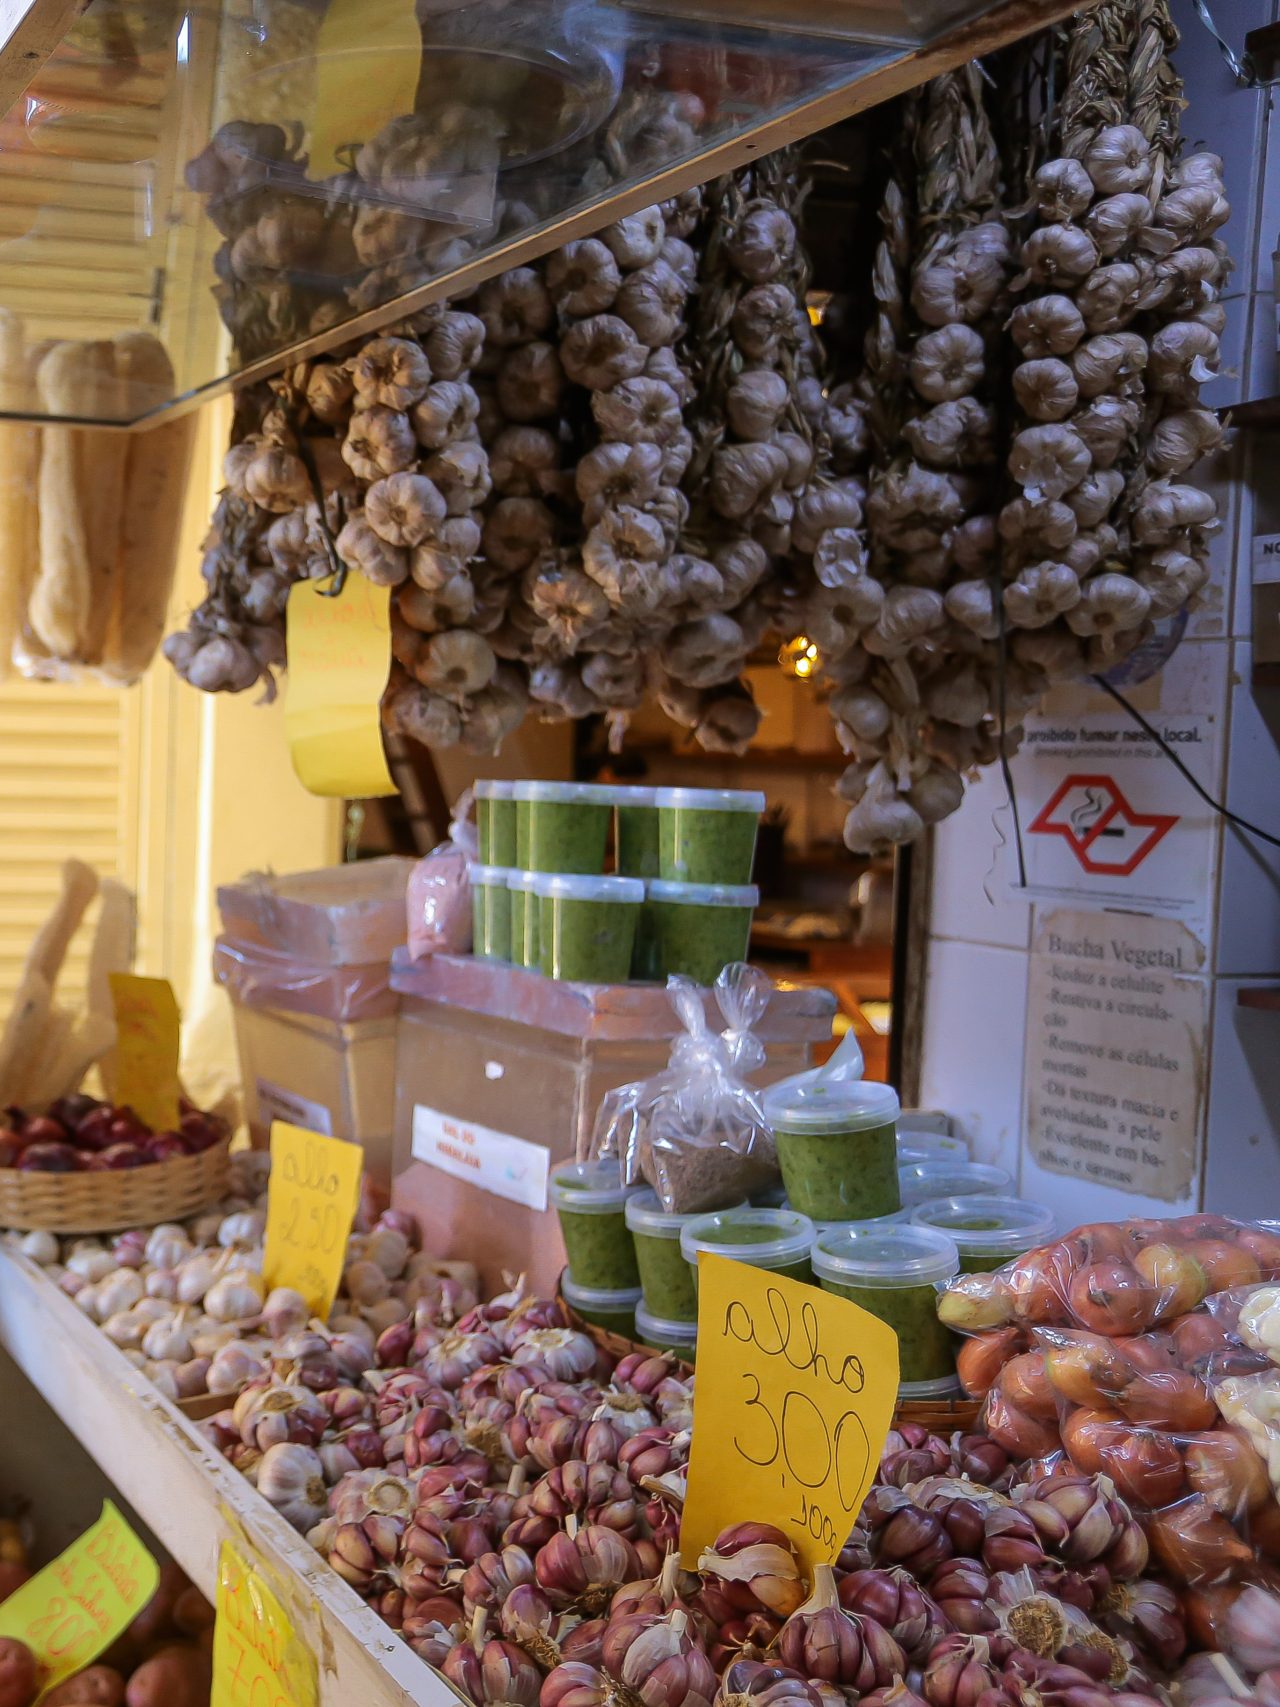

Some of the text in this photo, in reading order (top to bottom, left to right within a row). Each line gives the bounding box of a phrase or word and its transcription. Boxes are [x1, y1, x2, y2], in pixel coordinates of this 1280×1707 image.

[1080, 727, 1118, 743] fumar
[1164, 727, 1202, 742] local.
[1049, 933, 1182, 970] Bucha Vegetal
[1110, 974, 1165, 995] celulite
[1108, 1048, 1123, 1061] as
[1042, 1058, 1087, 1078] mortas
[1069, 1086, 1118, 1108] textura
[1121, 1099, 1165, 1119] macia
[1169, 1110, 1179, 1123] e
[1130, 1124, 1162, 1142] pele
[1115, 1146, 1138, 1162] em
[282, 1139, 340, 1196] alho
[723, 1287, 865, 1394] alho
